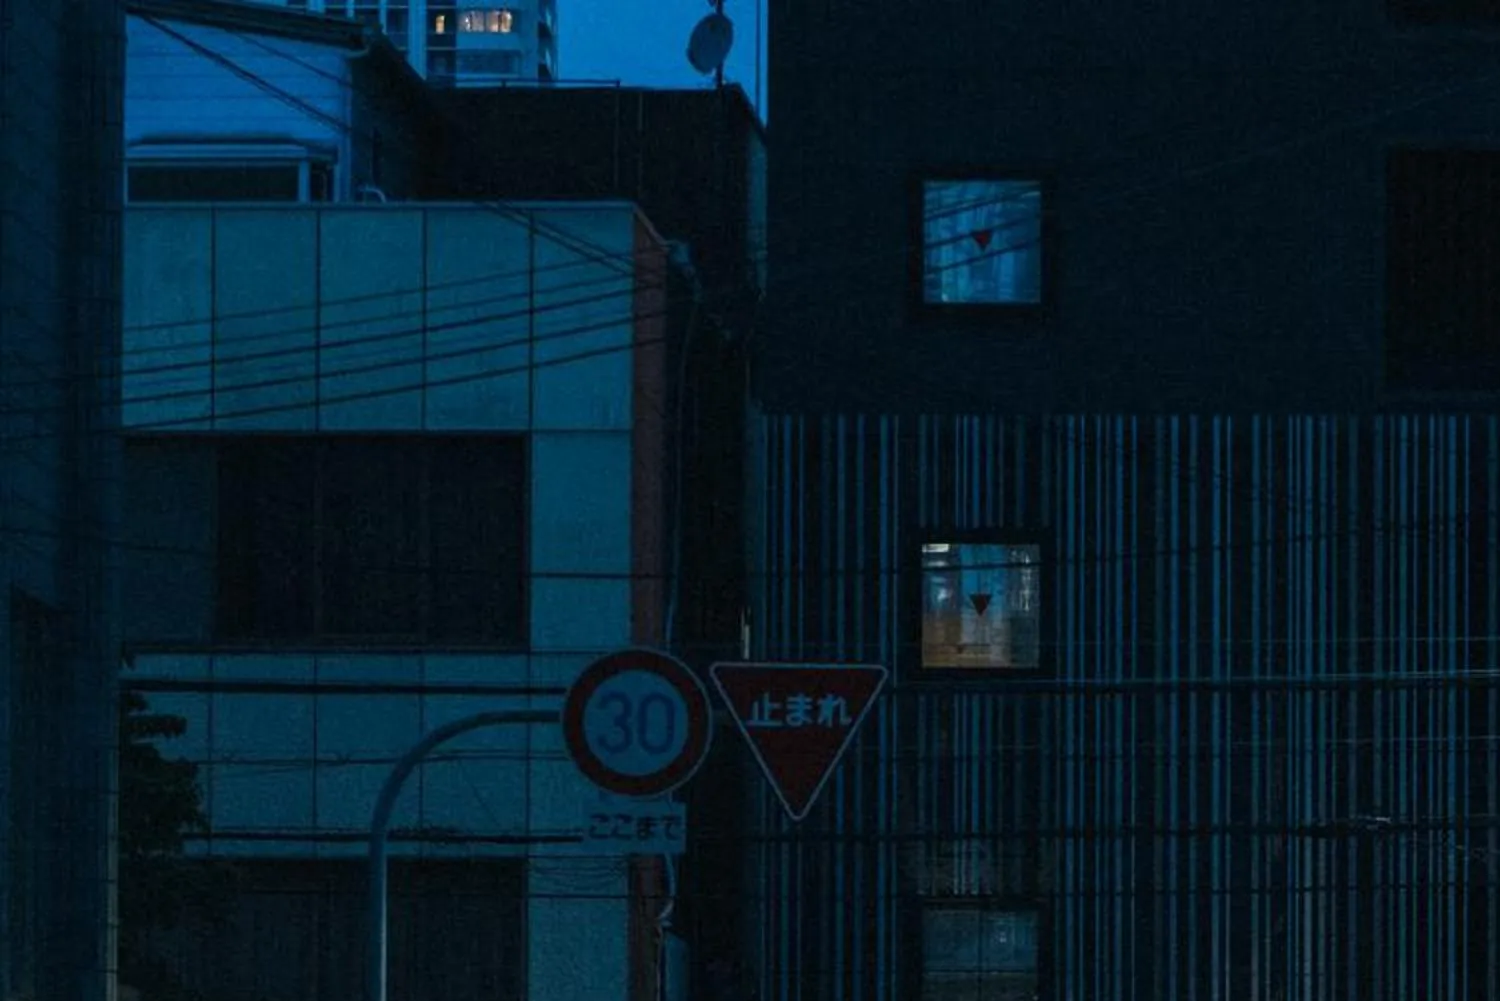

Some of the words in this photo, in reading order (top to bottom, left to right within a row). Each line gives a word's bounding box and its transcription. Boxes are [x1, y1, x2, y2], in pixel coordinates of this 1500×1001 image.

[595, 690, 676, 756] 30
[746, 690, 853, 729] 止まれ
[588, 812, 682, 841] ここまで
